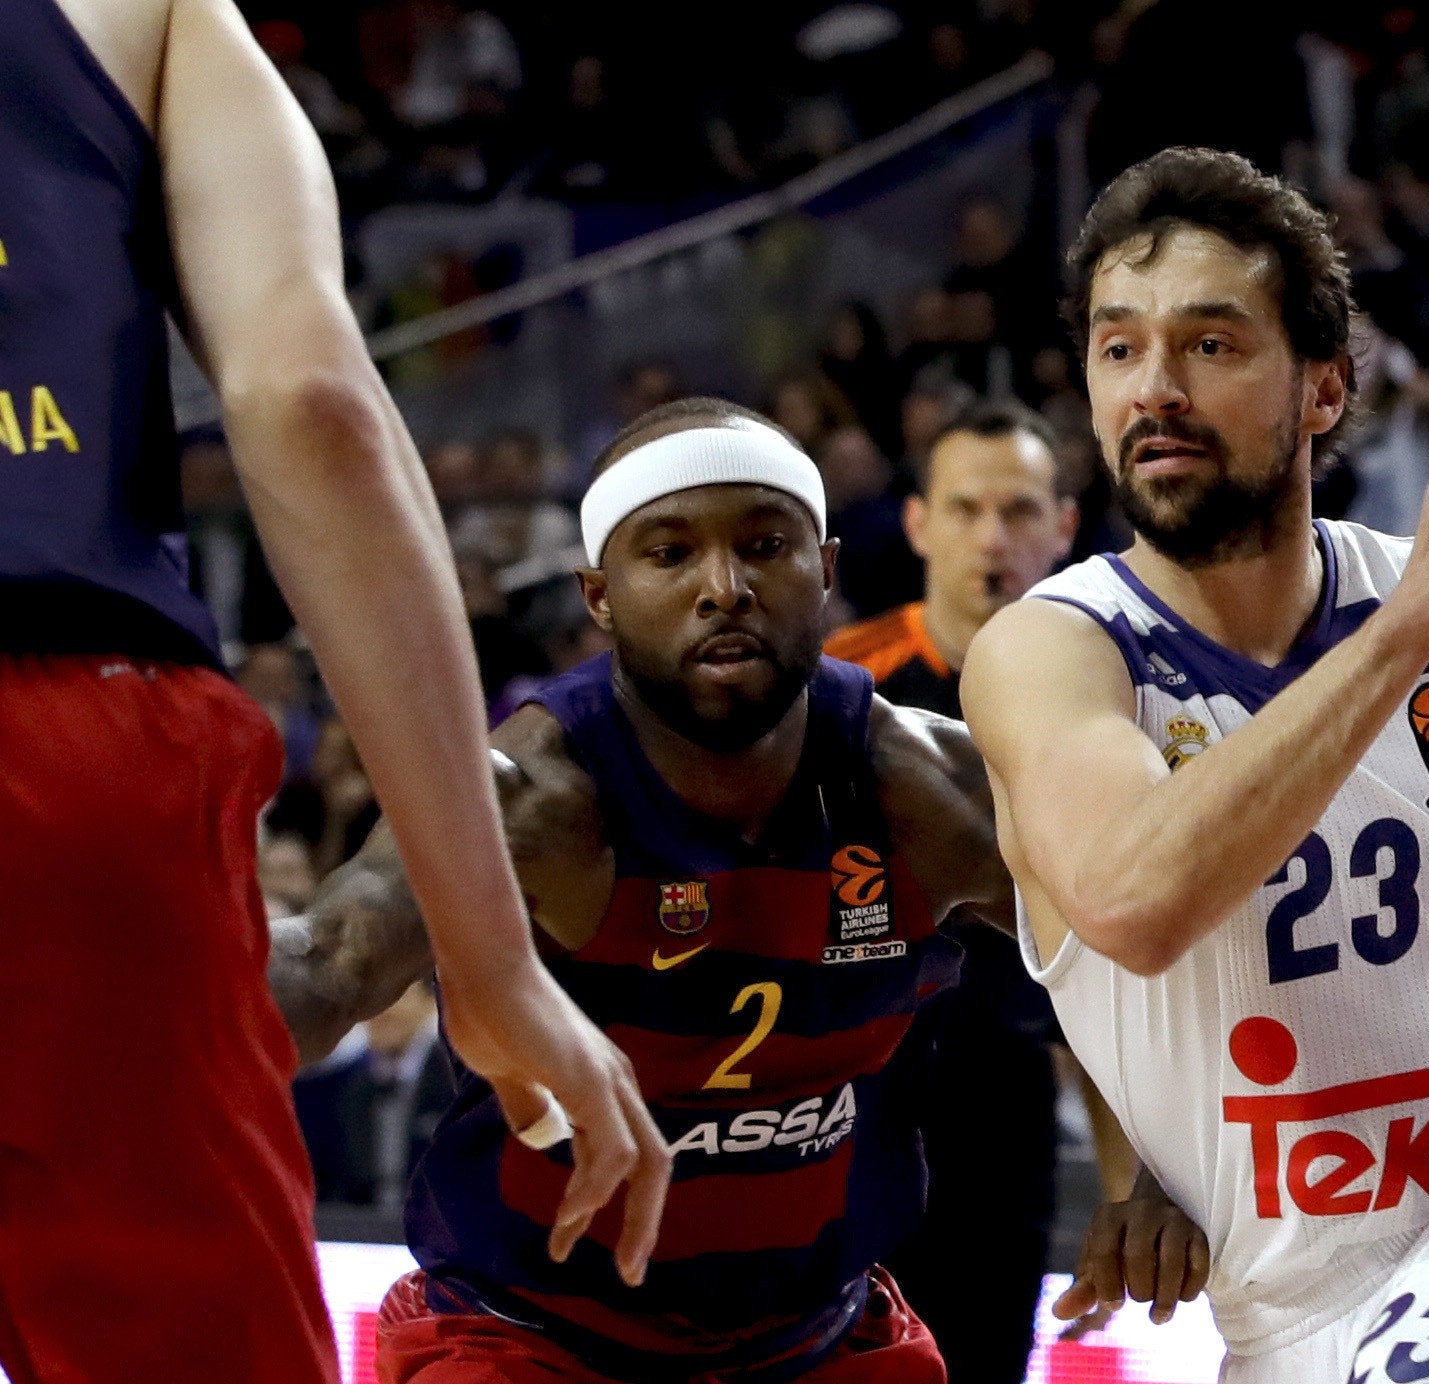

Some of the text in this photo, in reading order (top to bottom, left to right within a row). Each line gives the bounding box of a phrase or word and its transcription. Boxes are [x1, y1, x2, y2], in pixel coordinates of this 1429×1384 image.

[839, 903, 888, 920] TURKISH
[841, 913, 889, 931] AIRLINES
[1263, 816, 1421, 985] 23
[702, 981, 783, 1090] 2
[668, 1082, 857, 1155] ASSA
